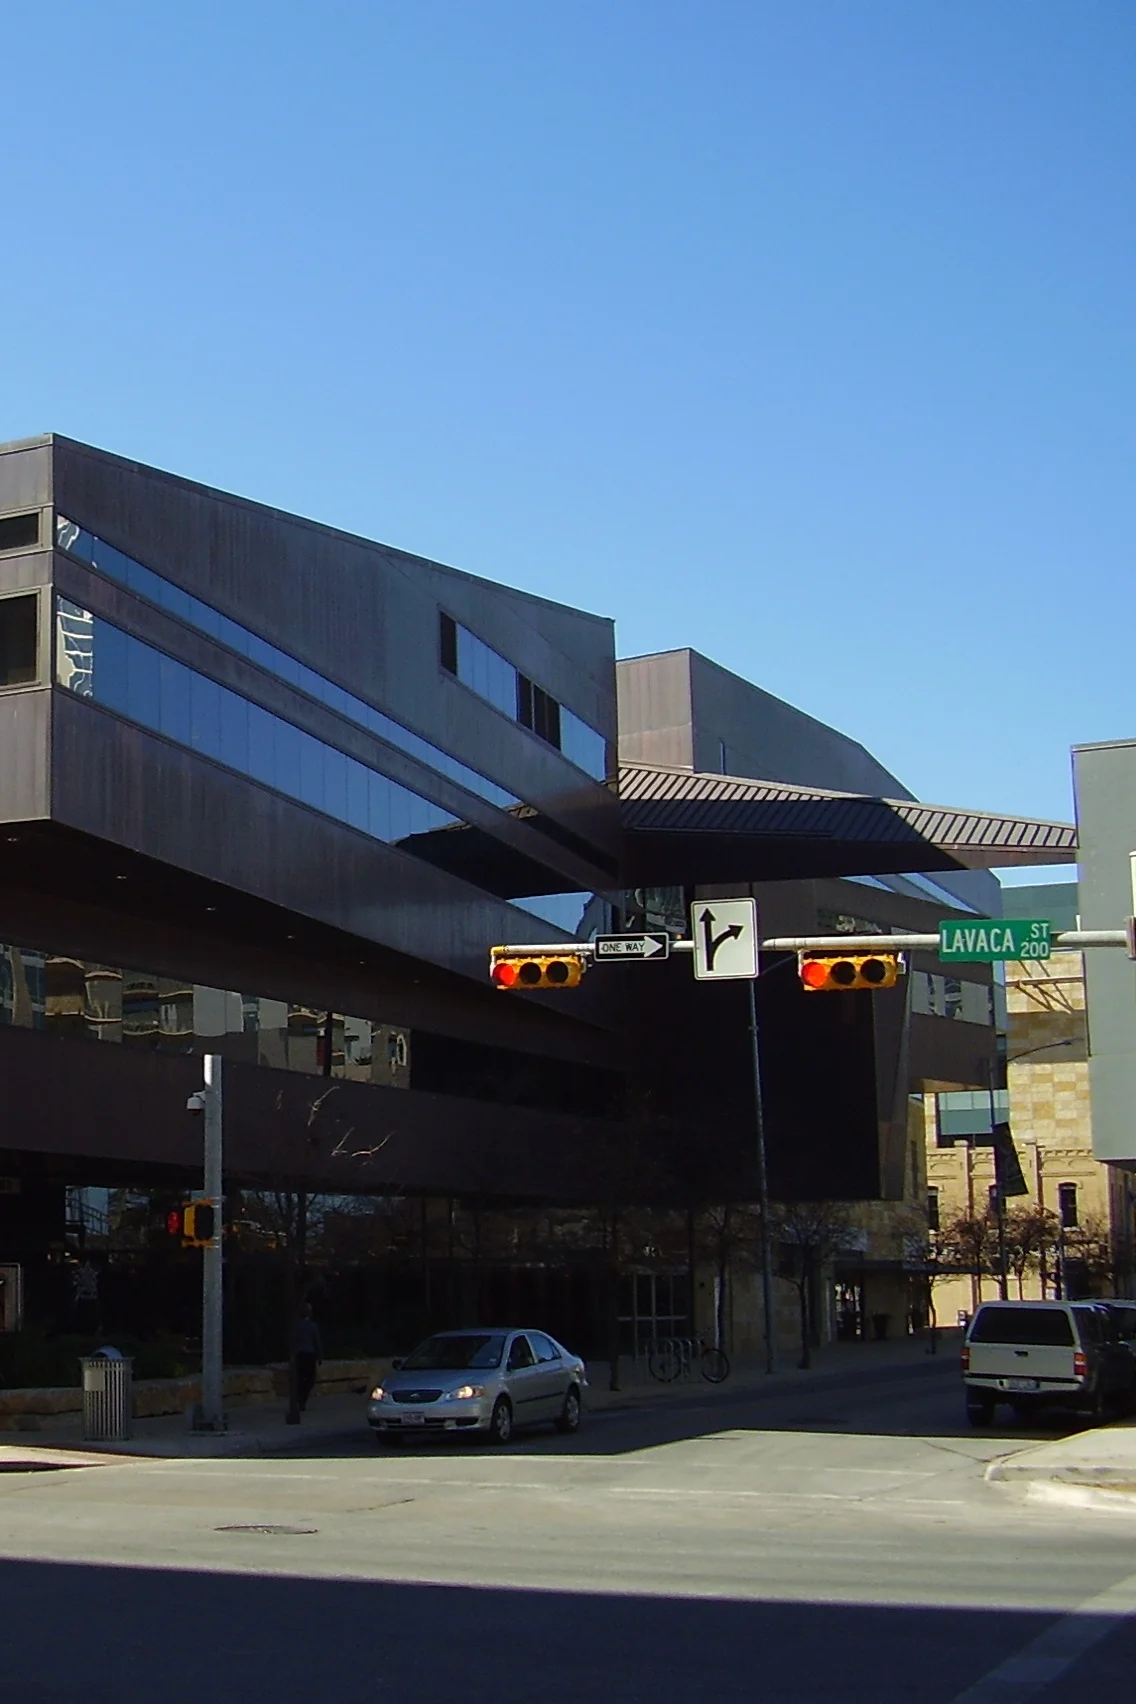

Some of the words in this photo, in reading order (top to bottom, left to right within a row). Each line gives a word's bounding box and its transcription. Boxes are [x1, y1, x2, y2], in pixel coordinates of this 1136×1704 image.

[941, 927, 1015, 953] LAVACA
[1030, 922, 1049, 938] ST
[601, 942, 622, 953] ONE
[625, 941, 645, 952] WAY
[1020, 941, 1049, 957] 200
